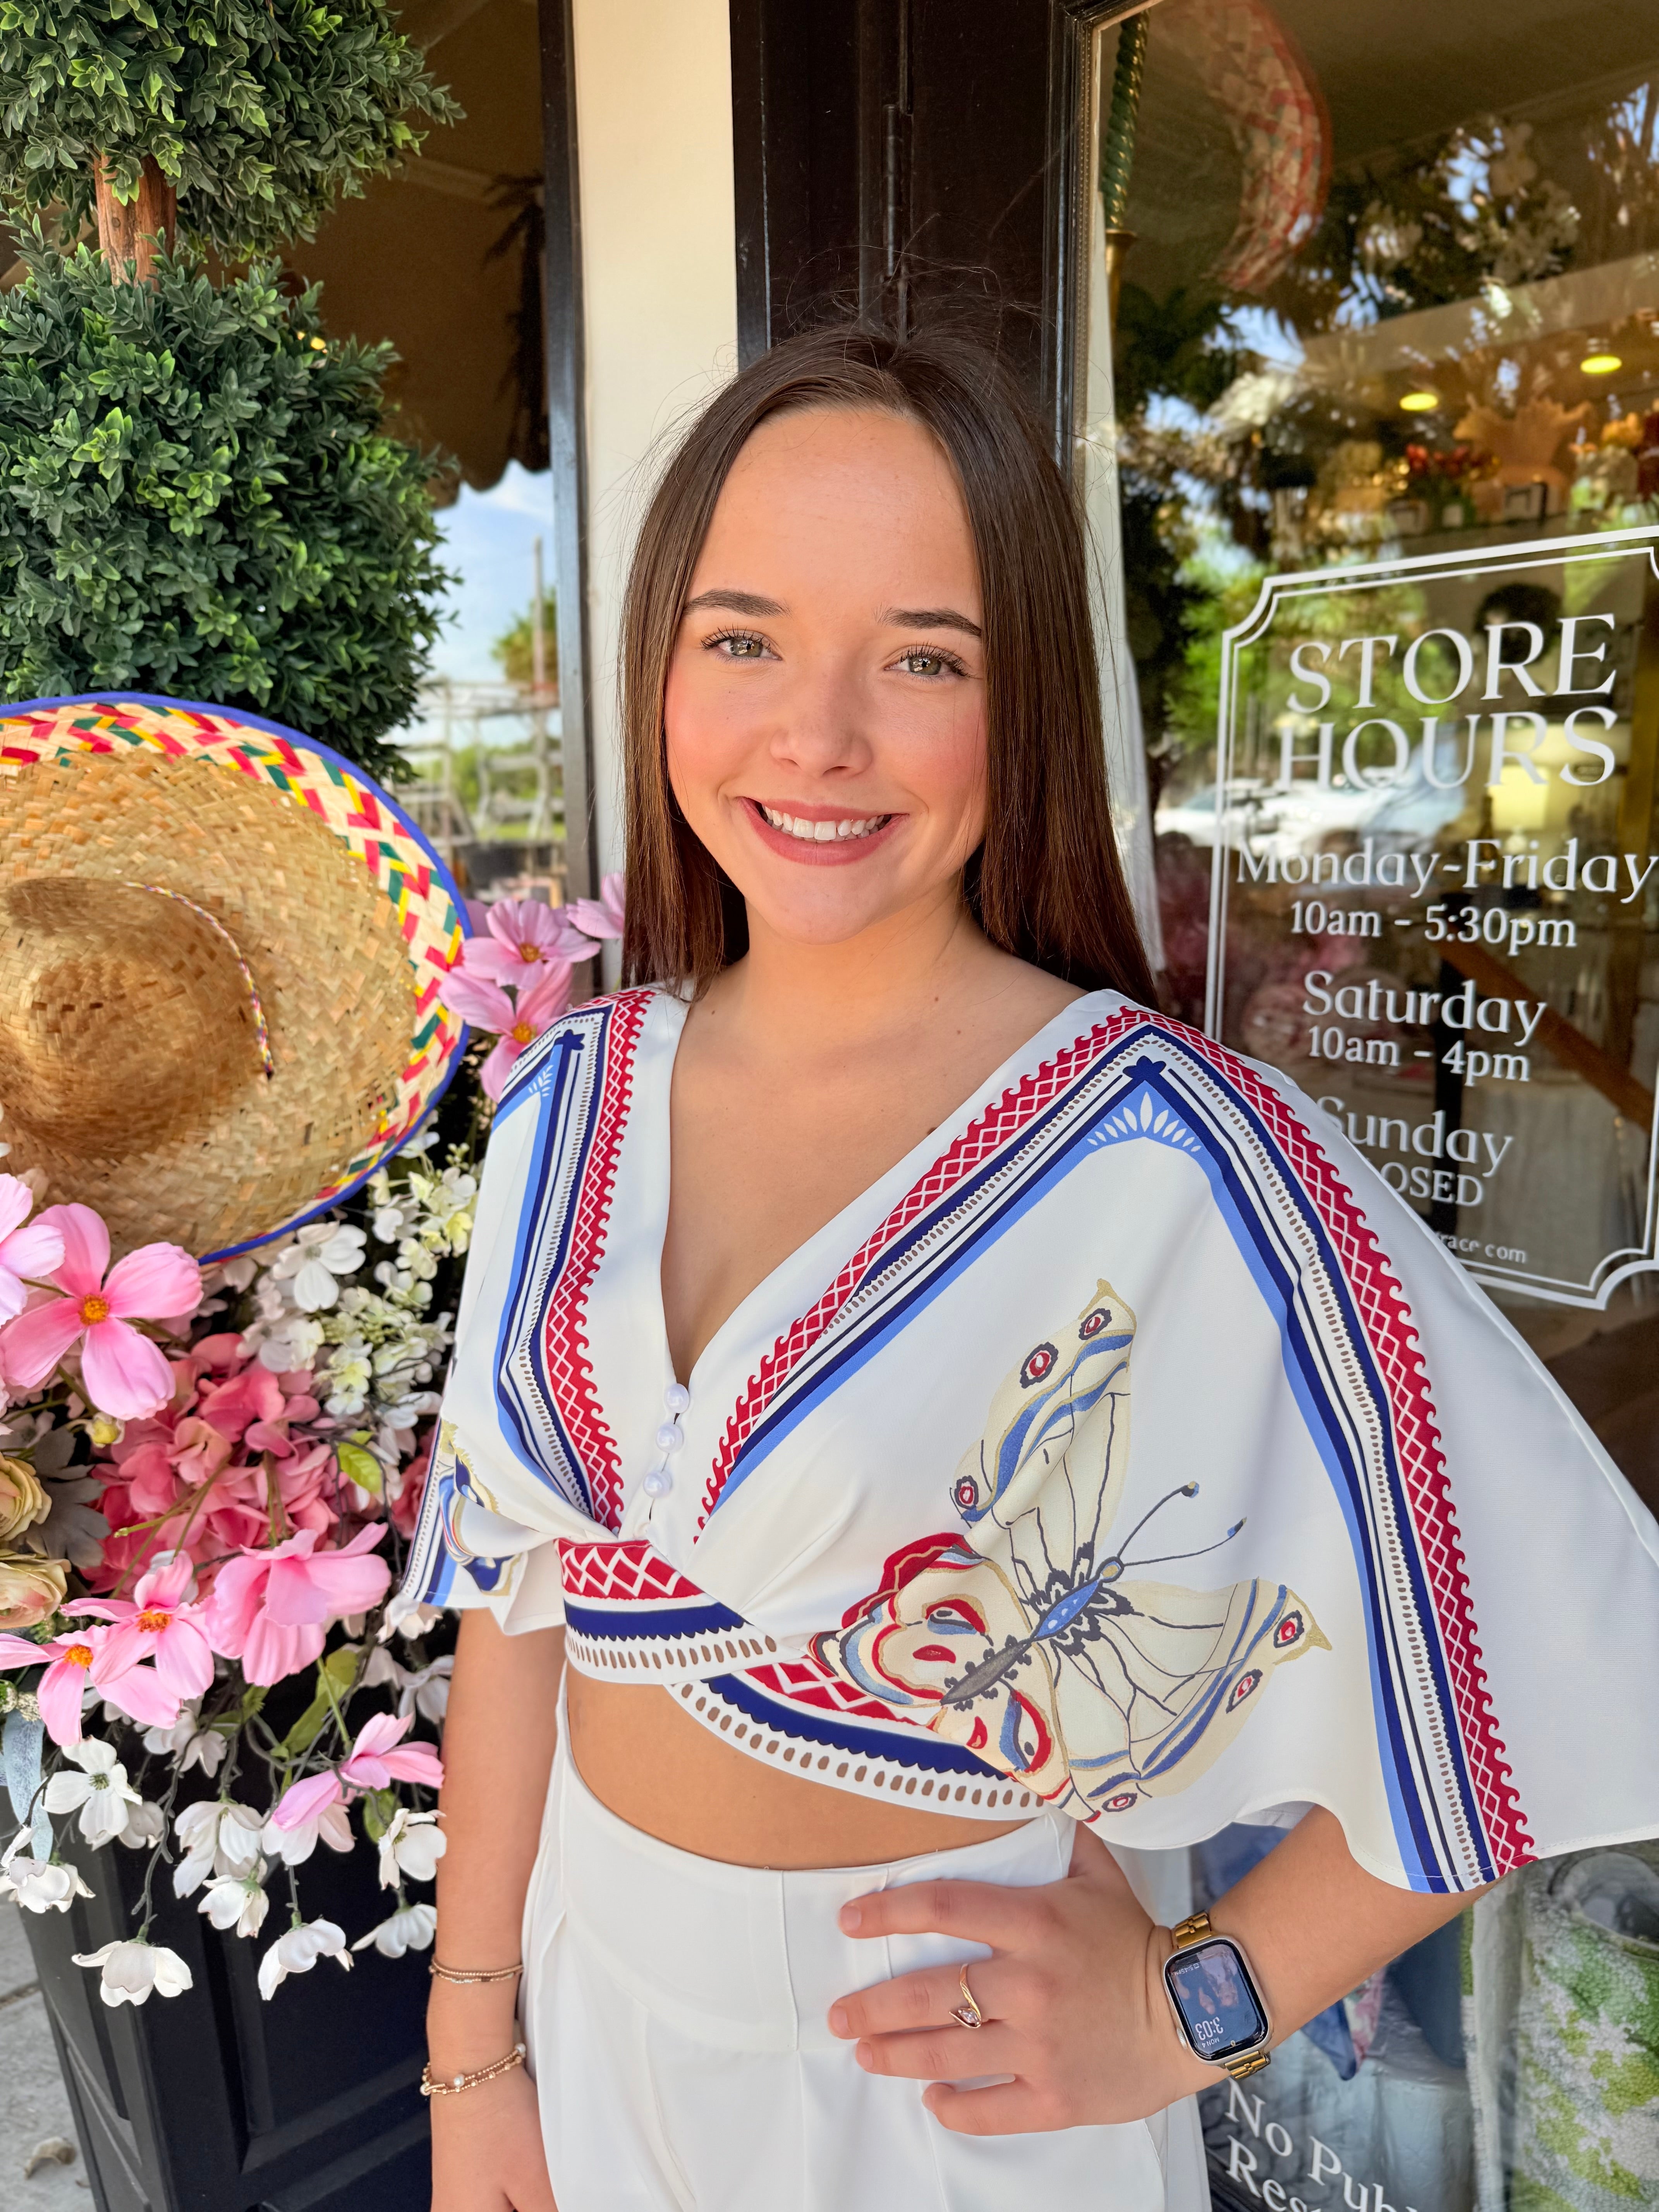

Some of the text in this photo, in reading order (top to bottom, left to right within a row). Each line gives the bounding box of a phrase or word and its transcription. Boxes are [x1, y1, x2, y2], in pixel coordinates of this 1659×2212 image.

[1287, 613, 1617, 713] STORE
[1278, 706, 1618, 792] HOURS
[1237, 837, 1659, 903] Monday-Friday
[1291, 900, 1382, 938] 10am
[1424, 904, 1577, 957] 5:30pm
[1302, 970, 1547, 1047] Saturday
[1309, 1025, 1400, 1066] 10am
[1441, 1039, 1530, 1086] 4pm
[1317, 1096, 1514, 1178] Sunday
[1379, 1161, 1484, 1207] OSED
[1195, 2016, 1224, 2041] 3:03
[1207, 2037, 1220, 2047] MON
[1224, 2076, 1418, 2212] No Pub
